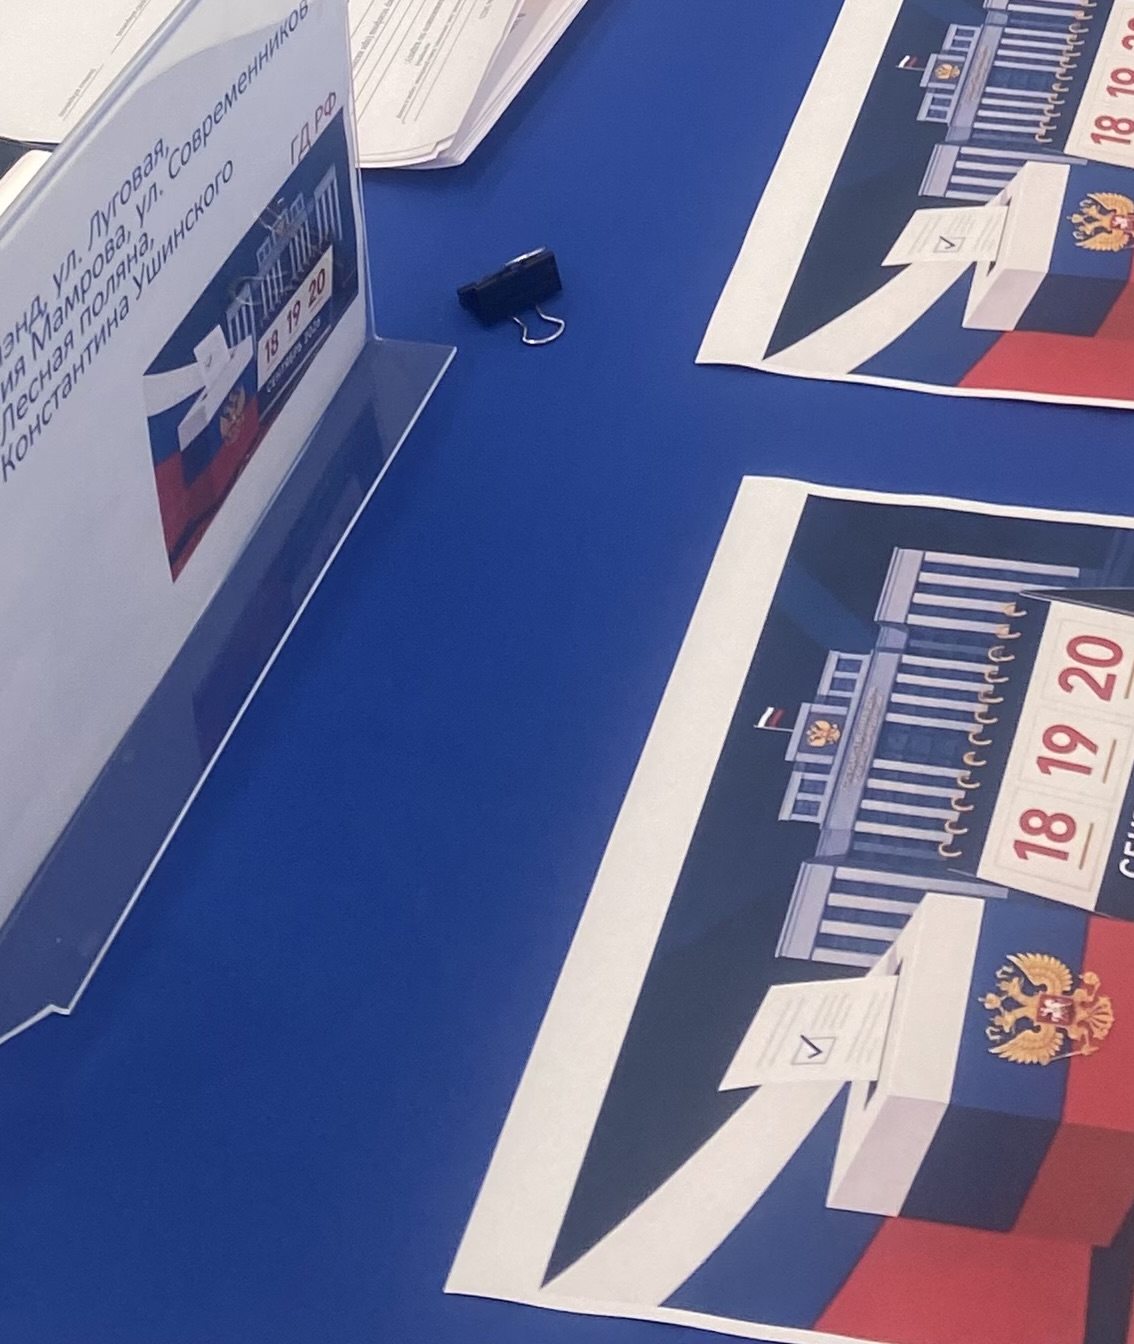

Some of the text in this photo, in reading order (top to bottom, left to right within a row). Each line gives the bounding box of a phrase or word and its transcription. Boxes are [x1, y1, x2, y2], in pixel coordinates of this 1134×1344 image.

[290, 91, 337, 166] ГД РФ
[31, 224, 131, 362] Мамрова,
[135, 181, 164, 229] ул.
[53, 249, 83, 299] ул.
[88, 138, 170, 252] Луговая,
[80, 232, 155, 337] поляна,
[132, 160, 235, 301] Ушинского
[264, 267, 327, 365] 18 19 20
[1013, 634, 1124, 862] 18 19 20
